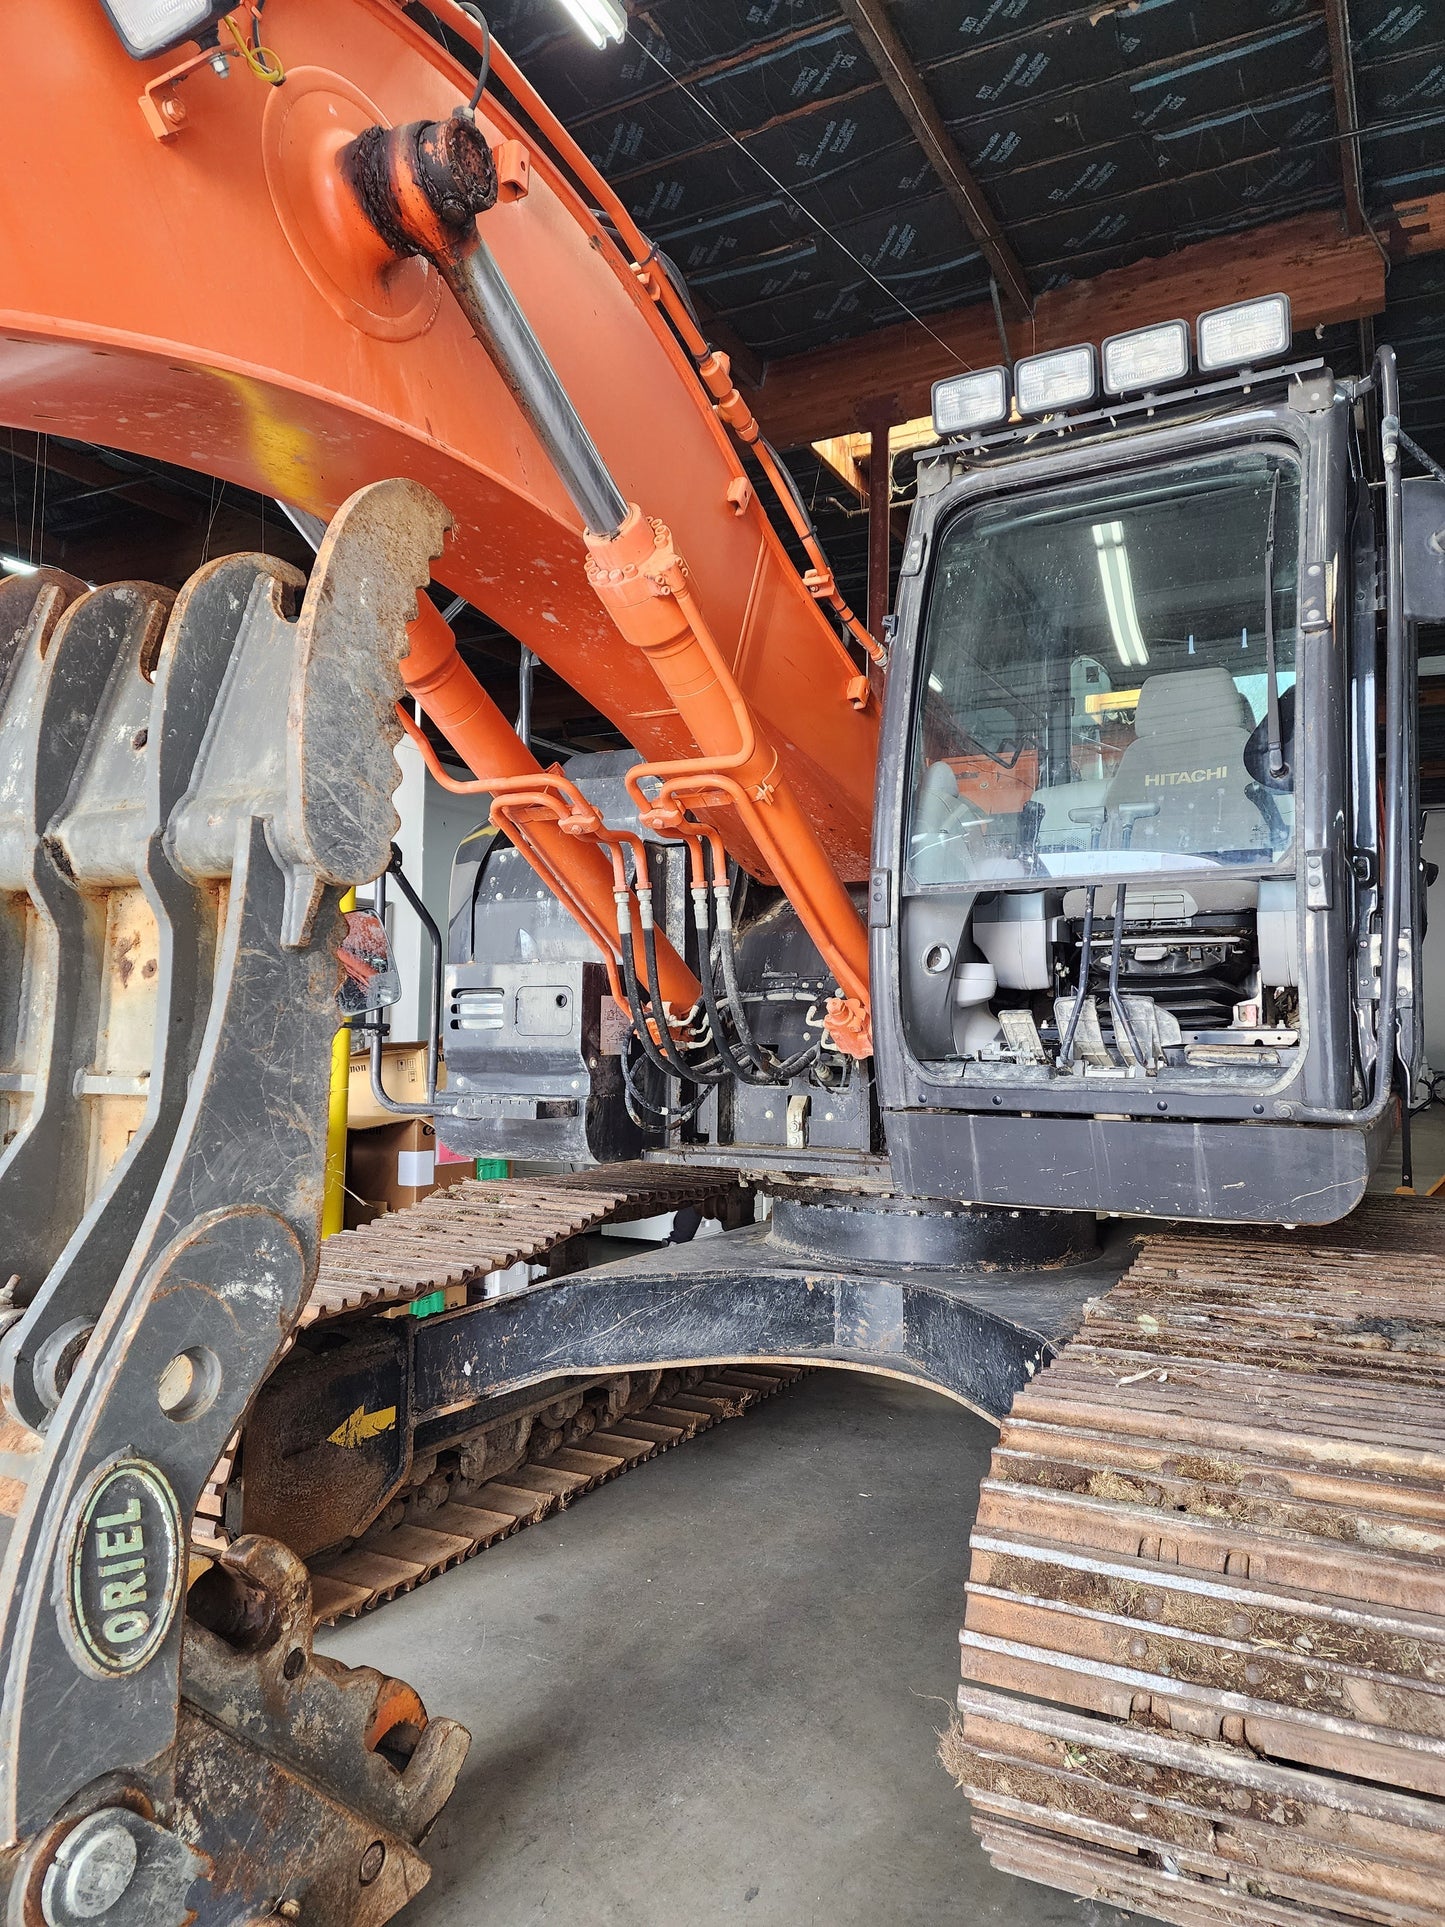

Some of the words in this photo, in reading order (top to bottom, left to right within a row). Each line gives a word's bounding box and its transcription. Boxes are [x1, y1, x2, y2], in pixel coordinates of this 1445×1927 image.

[988, 52, 1027, 101] Johns-Manville
[808, 119, 836, 167] Johns-Manville
[871, 224, 898, 268] Johns-Manville
[1144, 766, 1228, 787] HITACHI
[96, 1499, 150, 1643] ORIEL
